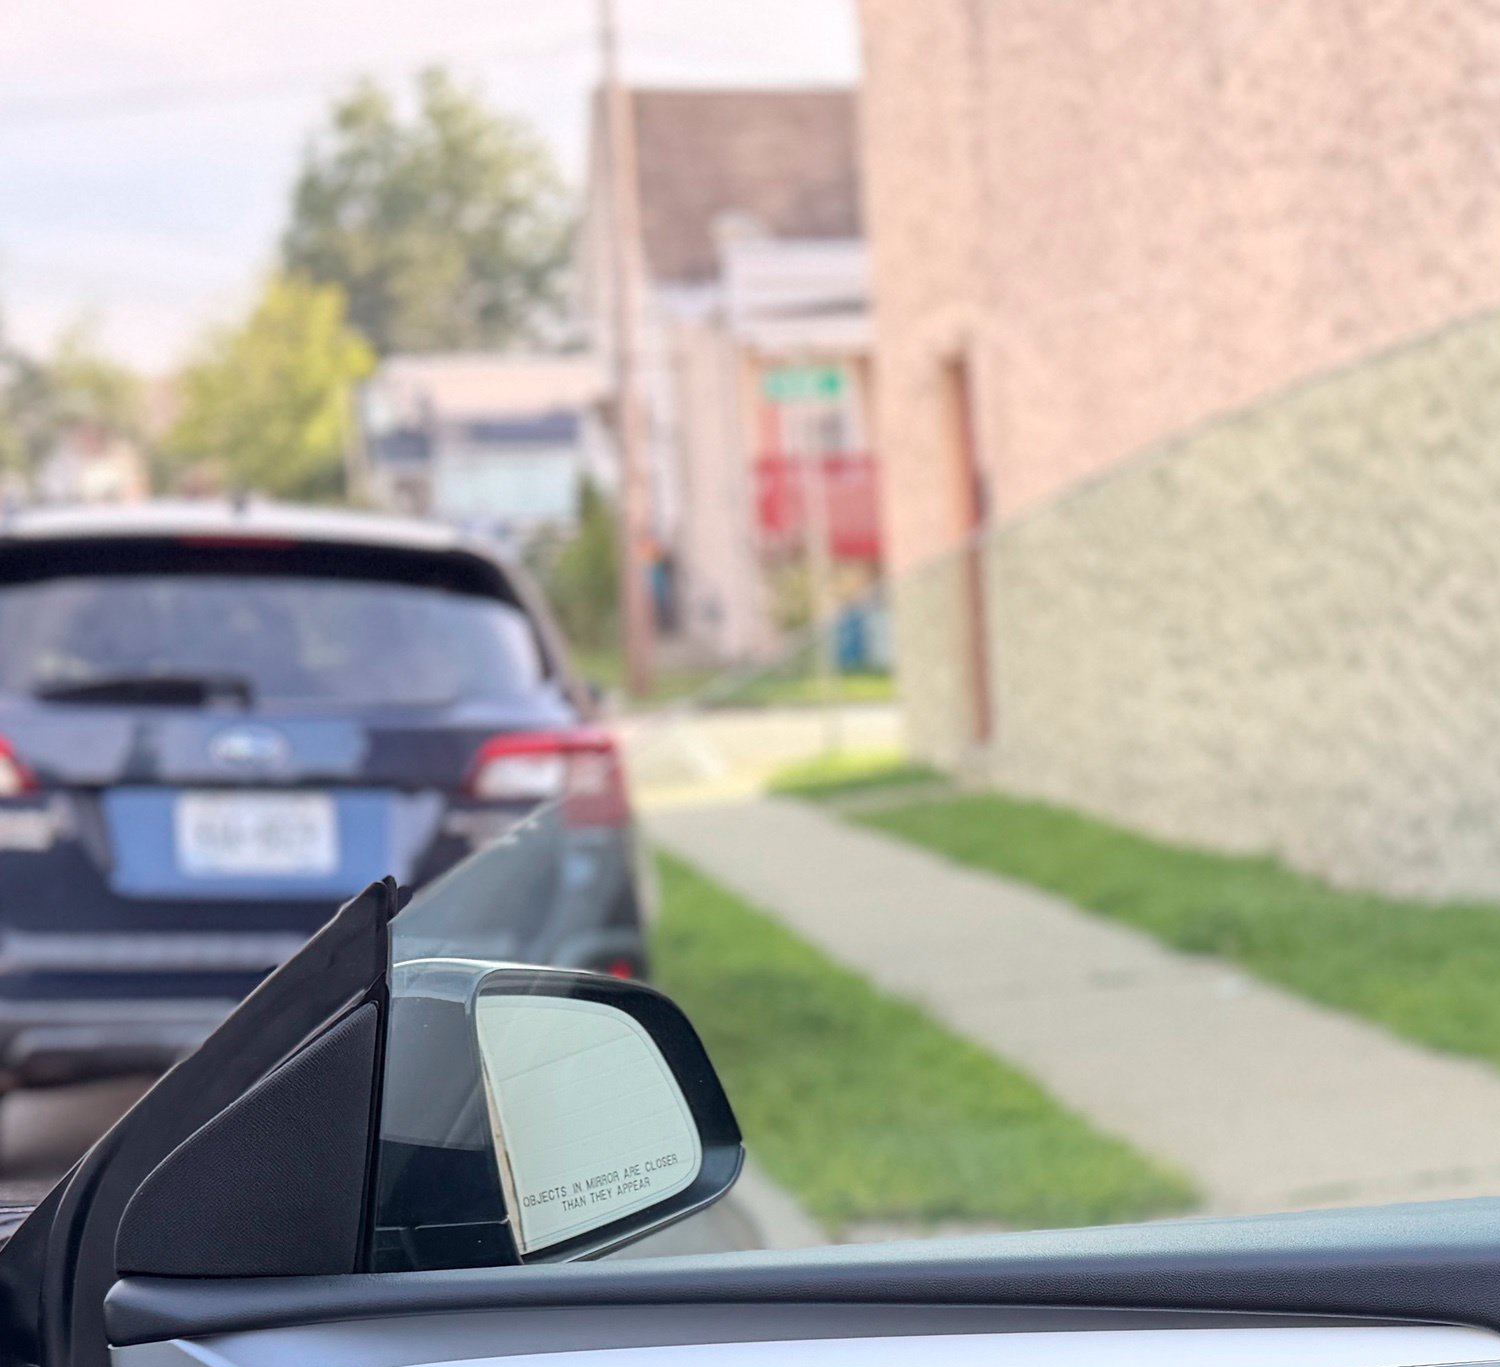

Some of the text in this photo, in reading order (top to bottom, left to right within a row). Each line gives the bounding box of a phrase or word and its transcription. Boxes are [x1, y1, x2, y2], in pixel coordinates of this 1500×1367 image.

[523, 1153, 679, 1208] OBJECTS IN MIRROR ARE CLOSER
[562, 1177, 651, 1211] THAN THEY APPEAR
